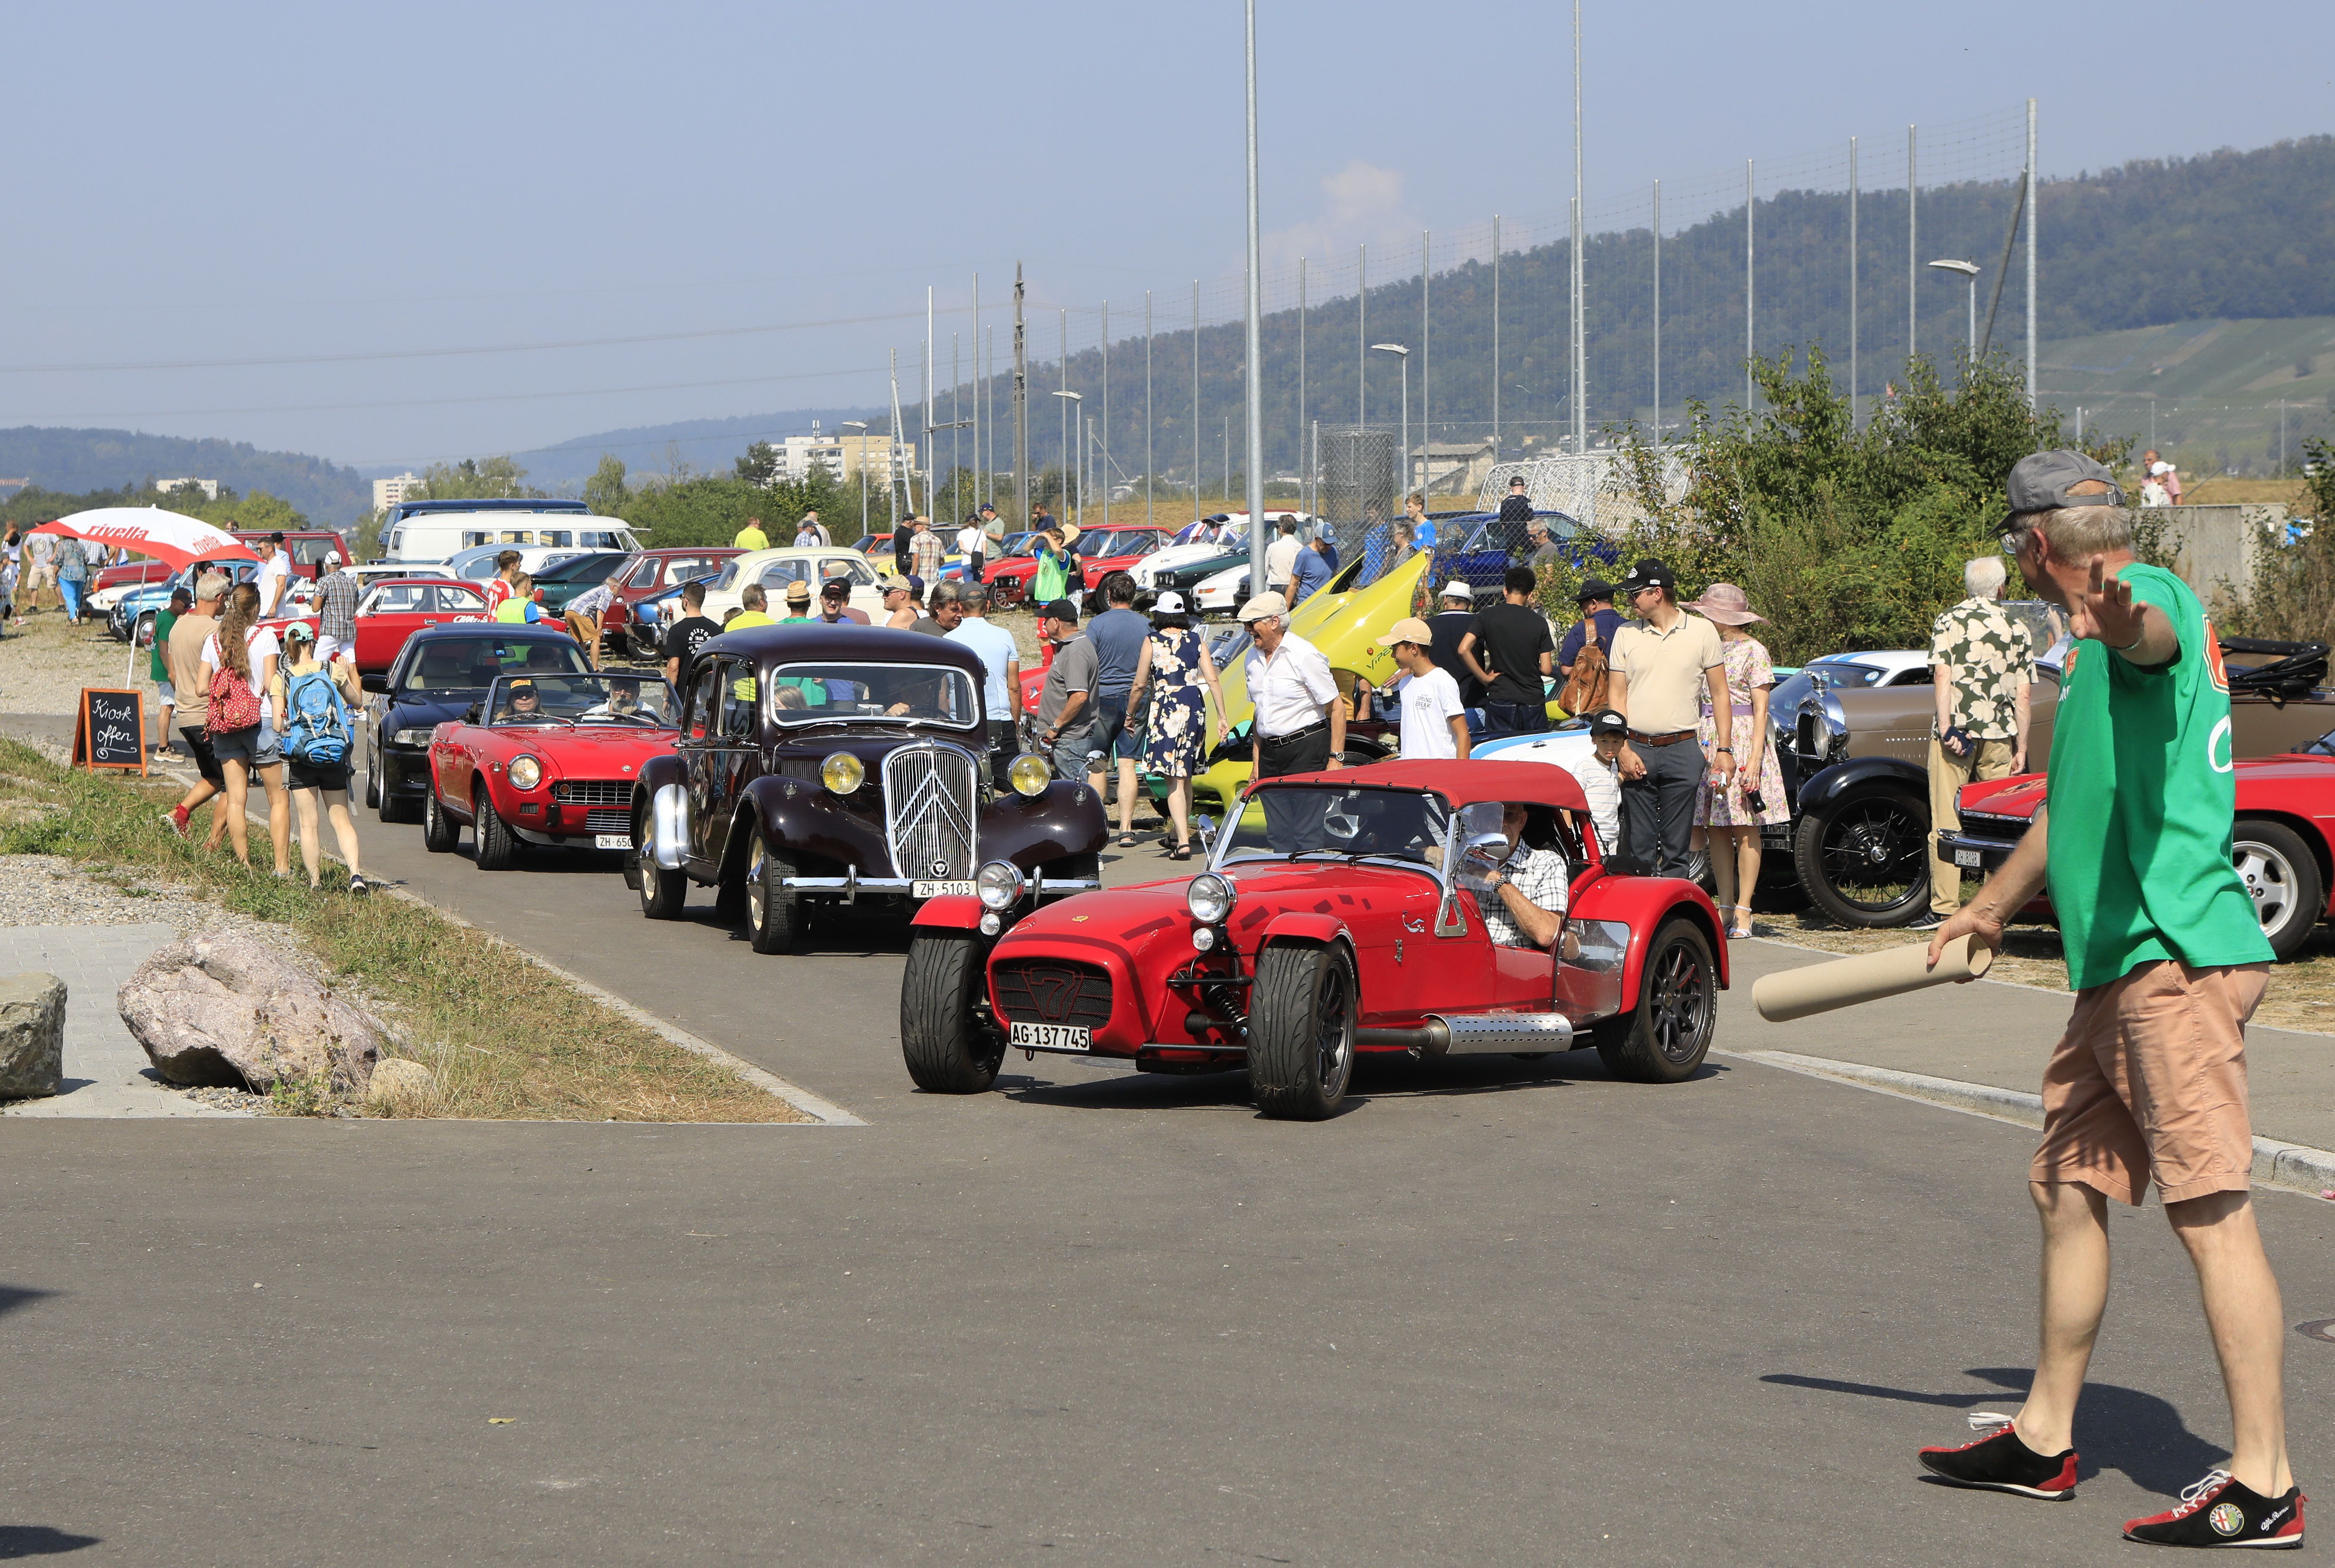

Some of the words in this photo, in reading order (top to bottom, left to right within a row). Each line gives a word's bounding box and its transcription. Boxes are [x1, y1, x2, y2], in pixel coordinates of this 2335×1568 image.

[86, 524, 150, 540] rivella
[193, 534, 221, 555] rivella
[92, 698, 132, 722] Kiosk
[1415, 701, 1431, 709] BREAK
[2221, 1505, 2242, 1519] ROMEO
